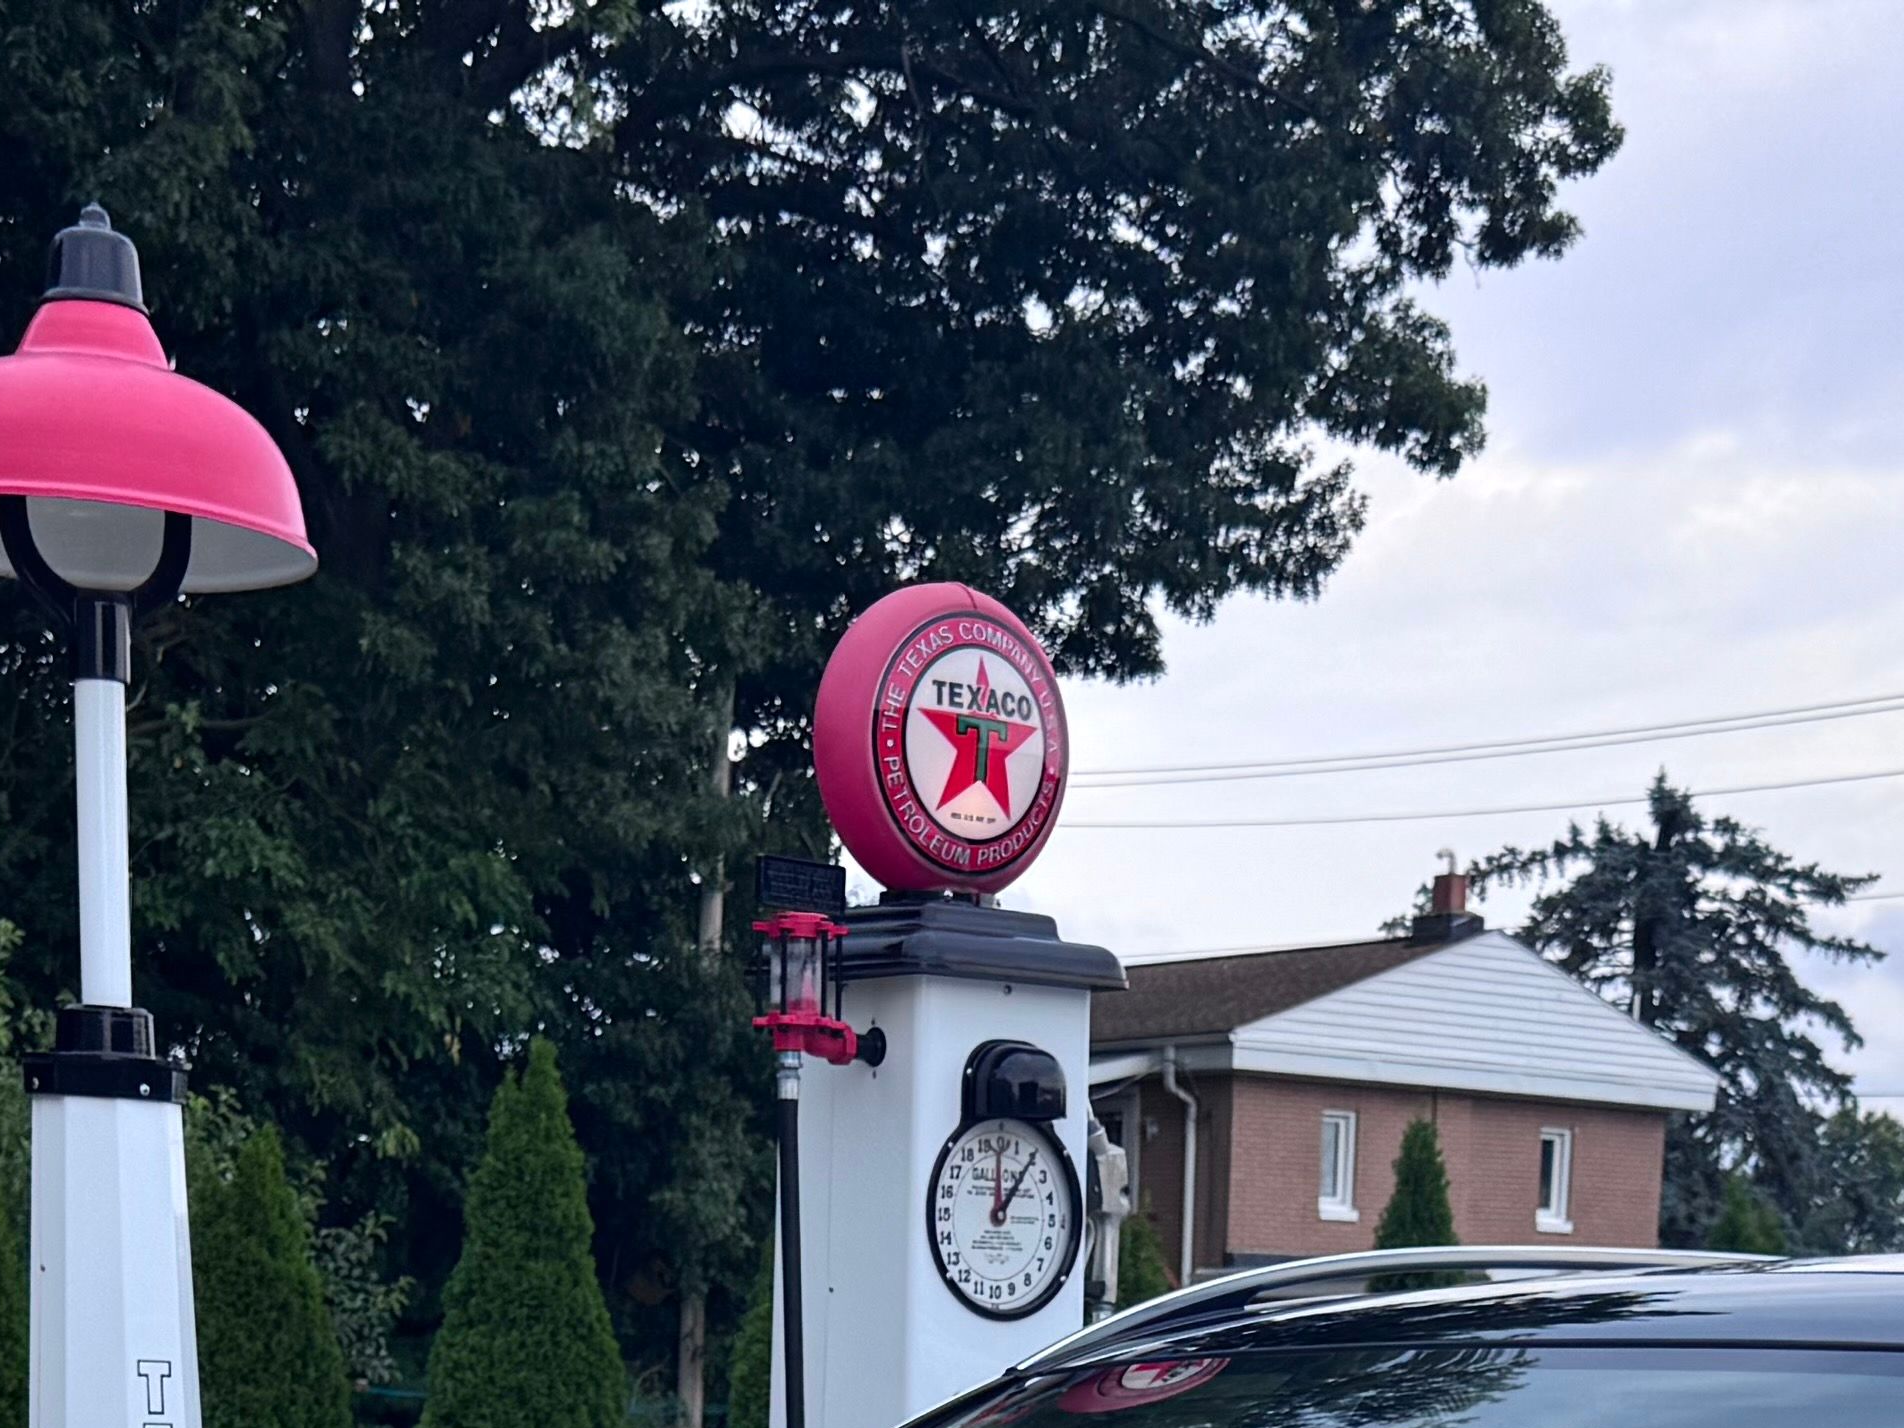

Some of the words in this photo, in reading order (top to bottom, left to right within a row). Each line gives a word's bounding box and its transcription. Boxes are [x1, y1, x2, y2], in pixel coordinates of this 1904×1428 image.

[881, 681, 907, 733] THE
[897, 624, 954, 678] TEXAS
[958, 621, 1042, 684] COMPANY
[931, 679, 1032, 721] TEXACO
[882, 754, 971, 866] PETROLEUM
[976, 783, 1056, 866] PRODUCTS
[961, 1146, 974, 1162] 18
[950, 1165, 962, 1180] 17
[1039, 1170, 1047, 1184] 3
[941, 1185, 954, 1200] 16
[1045, 1191, 1053, 1206] 4
[938, 1207, 951, 1222] 15
[1047, 1213, 1056, 1228] 5
[939, 1230, 952, 1245] 14
[1044, 1236, 1052, 1250] 6
[947, 1252, 960, 1266] 13
[1037, 1258, 1044, 1272] 7
[957, 1269, 971, 1283] 12
[1023, 1272, 1032, 1287] 8
[974, 1280, 984, 1295] 11
[989, 1285, 1002, 1299] 10
[1008, 1282, 1016, 1296] 9
